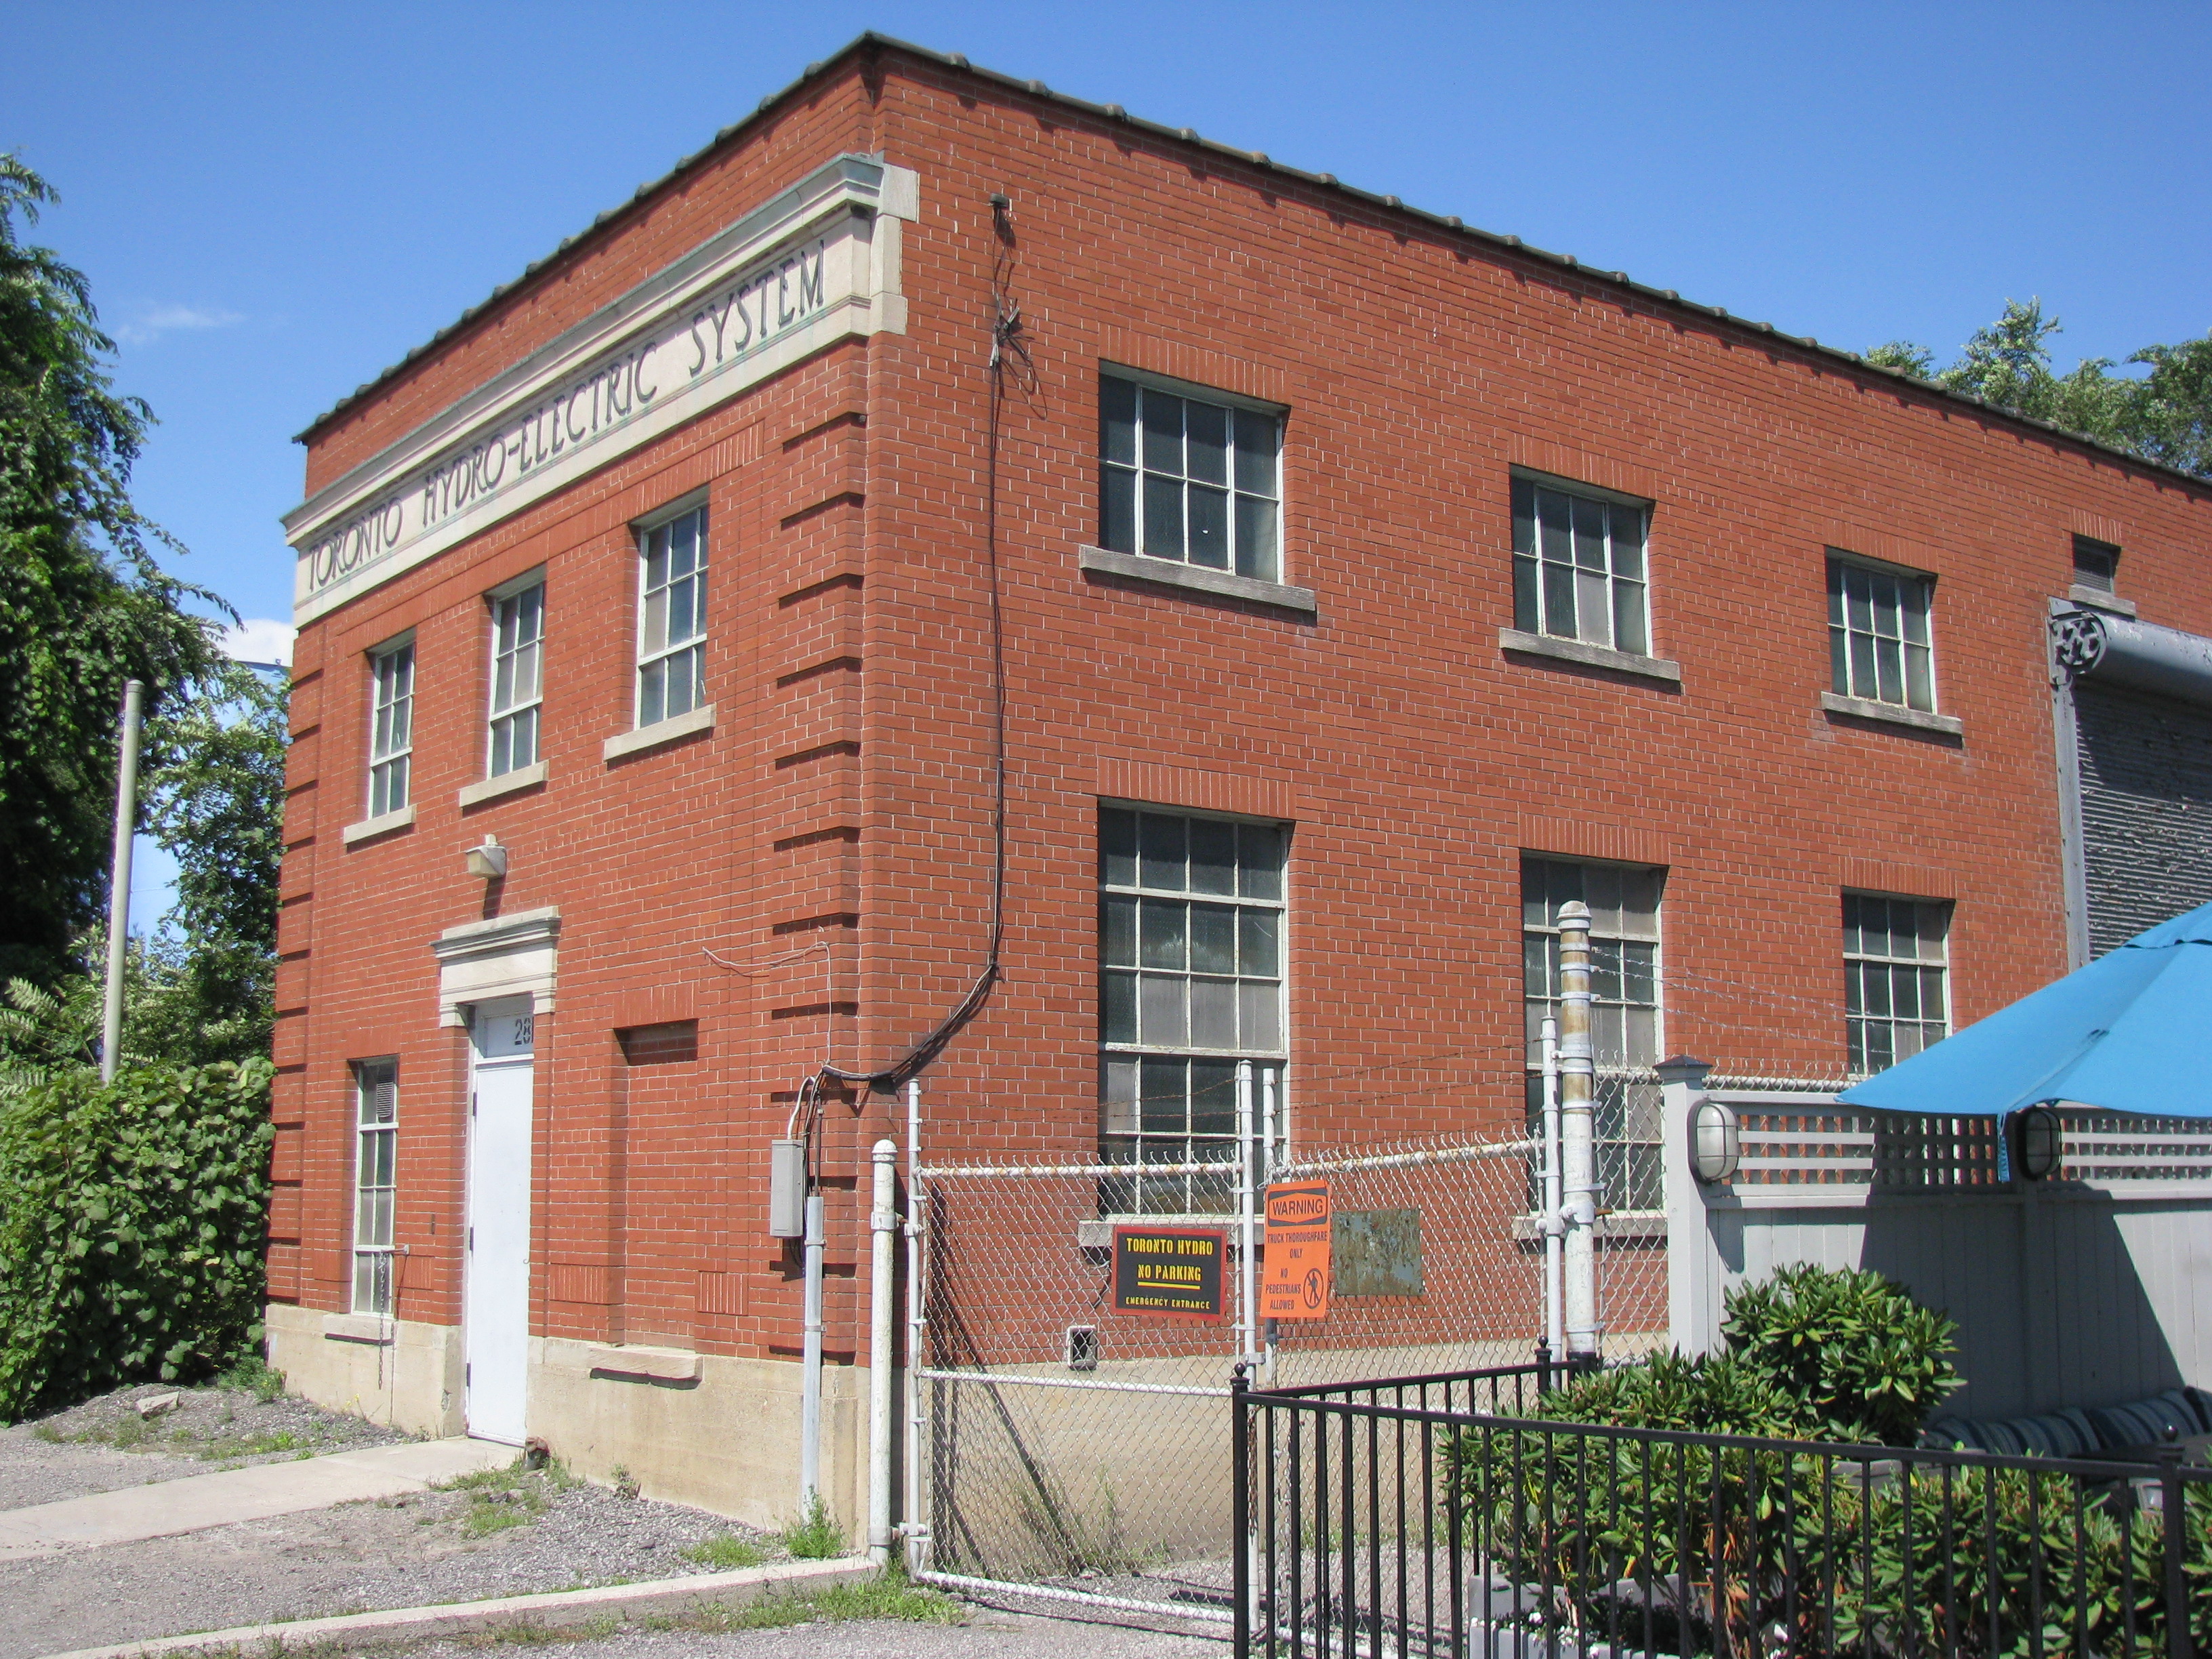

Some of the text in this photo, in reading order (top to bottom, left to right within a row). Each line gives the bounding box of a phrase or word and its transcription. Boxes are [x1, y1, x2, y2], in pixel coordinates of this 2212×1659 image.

[309, 239, 825, 592] TORONTO HYDRO-ELECTRIC SYSTEM
[1272, 1198, 1324, 1216] WARNING
[1267, 1231, 1328, 1244] TRUCK THOROUGHFARE
[1126, 1237, 1214, 1255] TORONTO HYDRO
[1290, 1248, 1303, 1258] ONLY
[1138, 1264, 1202, 1282] NO PARKING
[1280, 1267, 1288, 1278] NO
[1265, 1284, 1301, 1294] PEDESTRIANS
[1125, 1296, 1211, 1310] EMERGENCY ENTRANCE
[1269, 1299, 1294, 1310] ALLOWED
